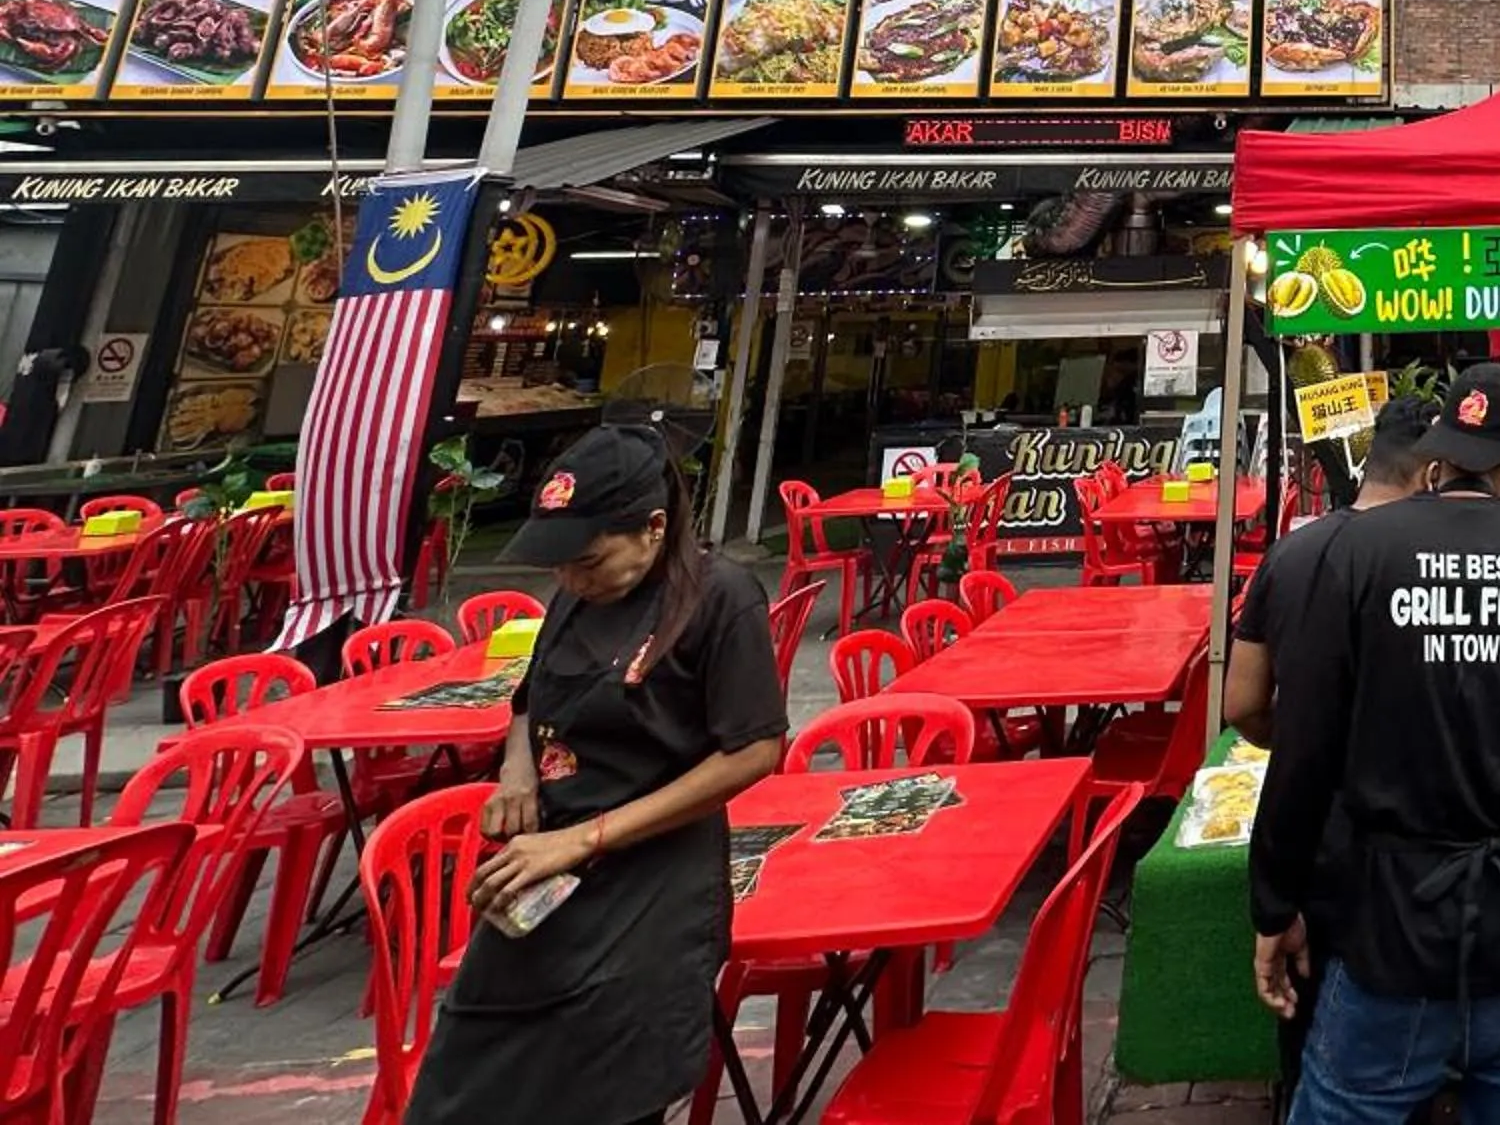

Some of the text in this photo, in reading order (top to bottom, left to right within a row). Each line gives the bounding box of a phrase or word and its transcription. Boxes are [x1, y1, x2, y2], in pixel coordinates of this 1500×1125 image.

[12, 176, 240, 199] KUNING IKAN BAKAR
[797, 168, 998, 191] KUNING IKAN BAKAR
[1074, 167, 1151, 189] KUNING
[1151, 169, 1202, 188] IKAN
[1375, 286, 1454, 322] WOW!
[1299, 378, 1364, 403] MUSANG KING
[1311, 395, 1359, 422] 猫山王
[1007, 428, 1181, 480] Kuning
[1029, 538, 1075, 552] FISH
[1415, 552, 1464, 580] THE
[1390, 586, 1477, 628] GRILL
[1423, 634, 1450, 663] IN
